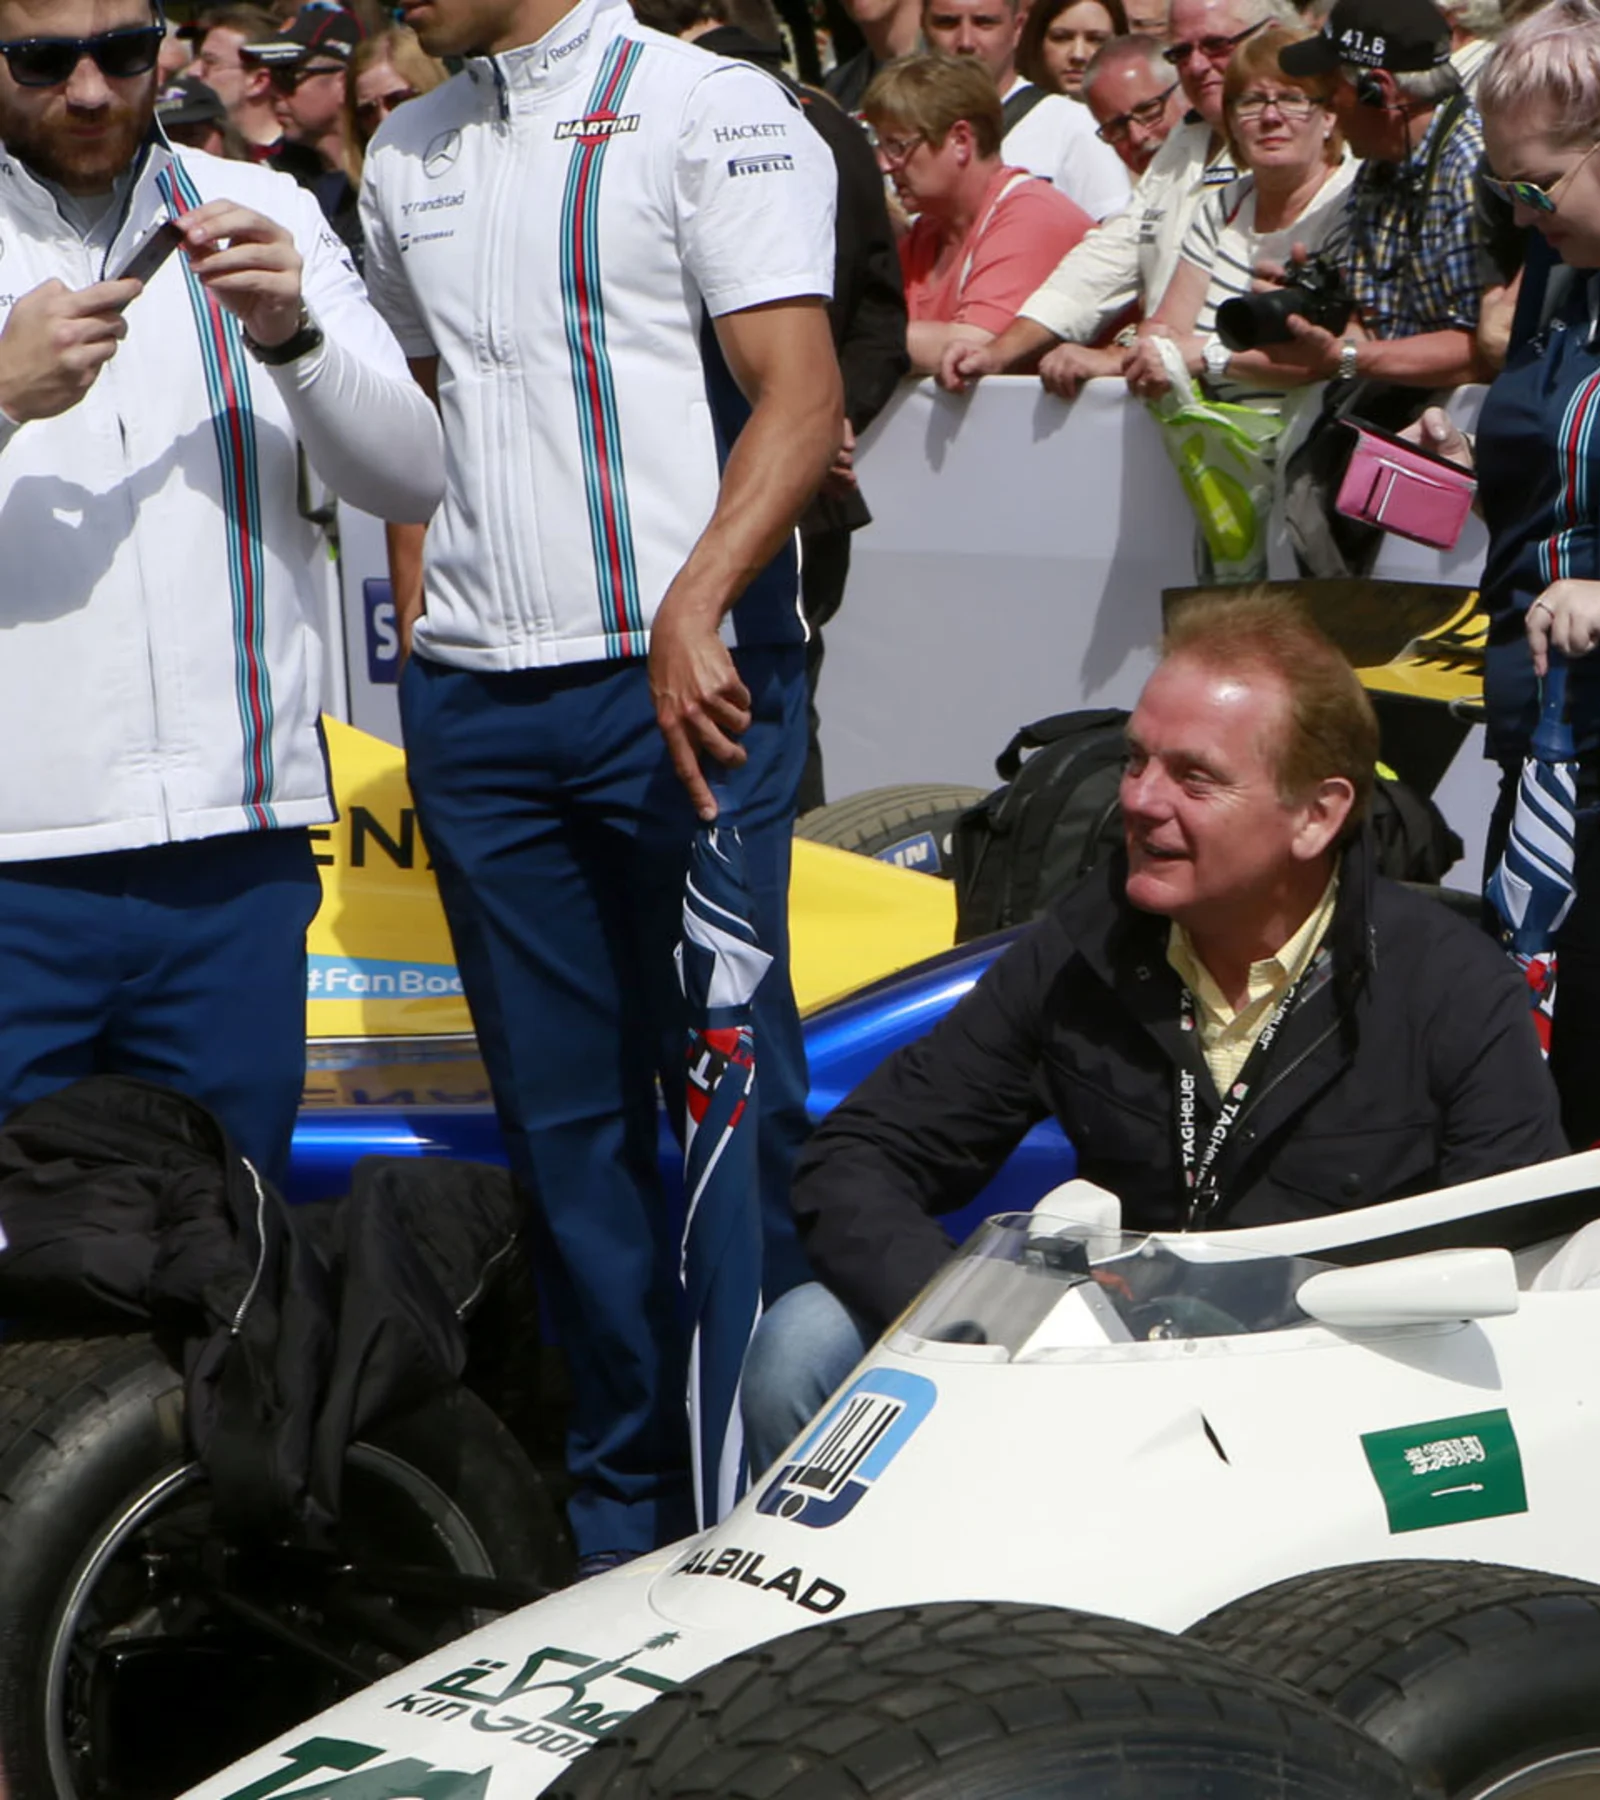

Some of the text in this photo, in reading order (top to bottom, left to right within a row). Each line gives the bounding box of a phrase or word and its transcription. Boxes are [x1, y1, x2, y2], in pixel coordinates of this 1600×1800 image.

[554, 114, 640, 140] MARTINI
[714, 123, 787, 143] HACKETT
[728, 154, 794, 178] PIRELLI
[672, 1548, 847, 1614] ALBILAD
